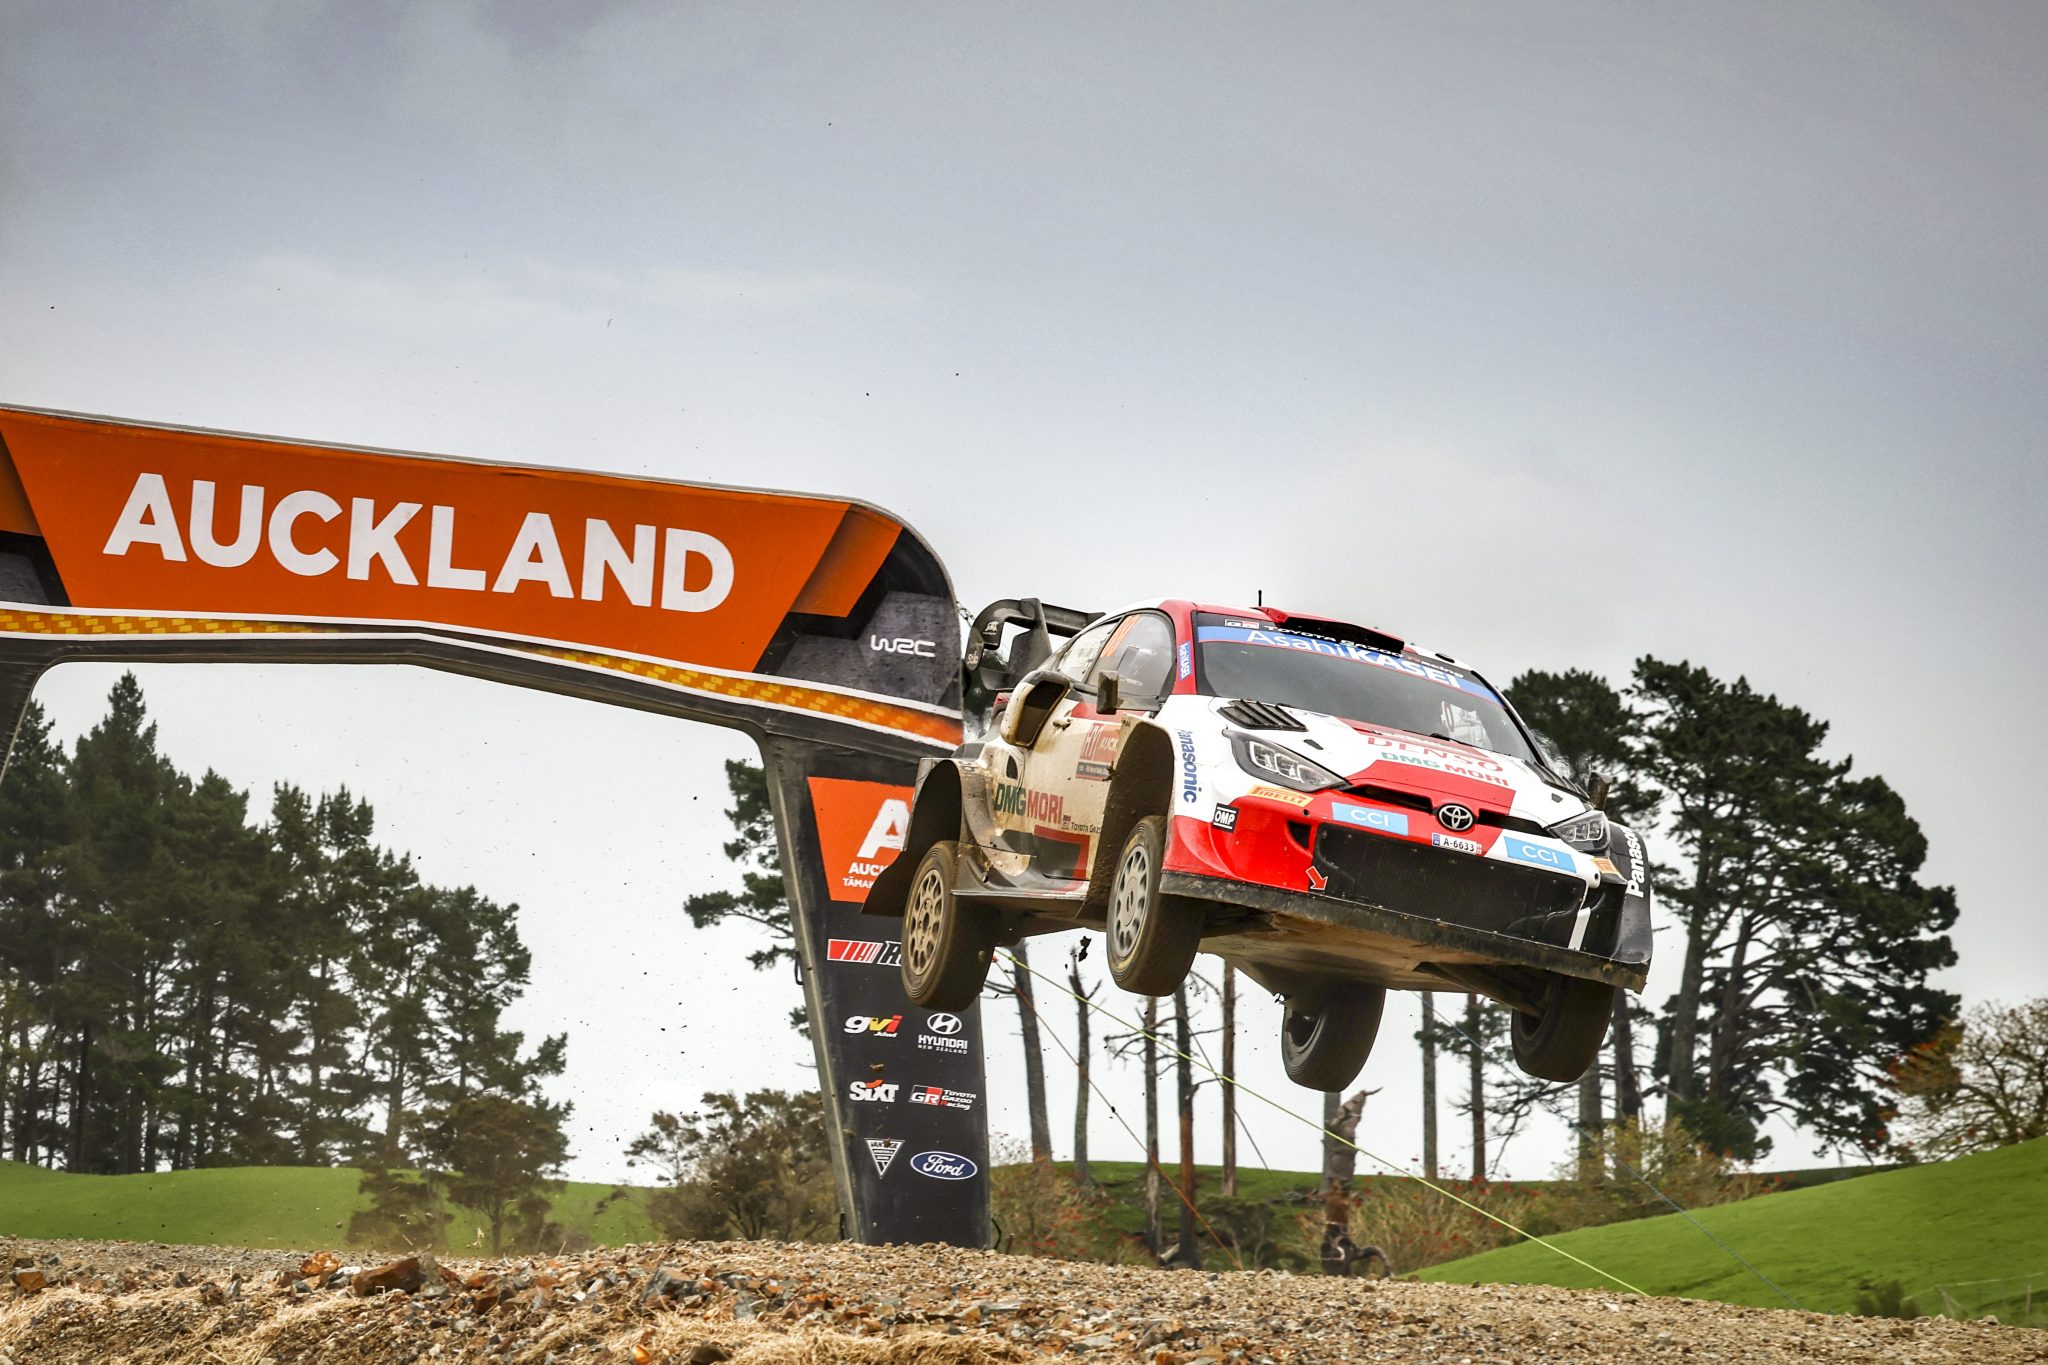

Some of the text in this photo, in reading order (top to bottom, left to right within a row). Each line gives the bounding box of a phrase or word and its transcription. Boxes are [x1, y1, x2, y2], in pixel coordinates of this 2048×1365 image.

[104, 473, 735, 614] AUCKLAND
[1264, 625, 1337, 642] TOYOTA
[870, 634, 936, 658] WRC
[1246, 630, 1461, 689] AsahiKASEI
[1367, 737, 1504, 773] DENSO
[1380, 751, 1509, 787] DMG MORI
[993, 783, 1064, 825] DMG MORI
[1214, 810, 1236, 826] OMP
[1350, 808, 1390, 827] CCI
[1443, 837, 1475, 853] A-6633
[1521, 845, 1559, 864] CCI
[843, 1014, 904, 1034] gvi
[918, 1034, 969, 1050] HYUNDAI
[935, 1046, 968, 1055] ZEALAND
[941, 1095, 973, 1104] GAZOO
[943, 1089, 977, 1099] TOYOTA
[922, 1154, 966, 1176] Ford
